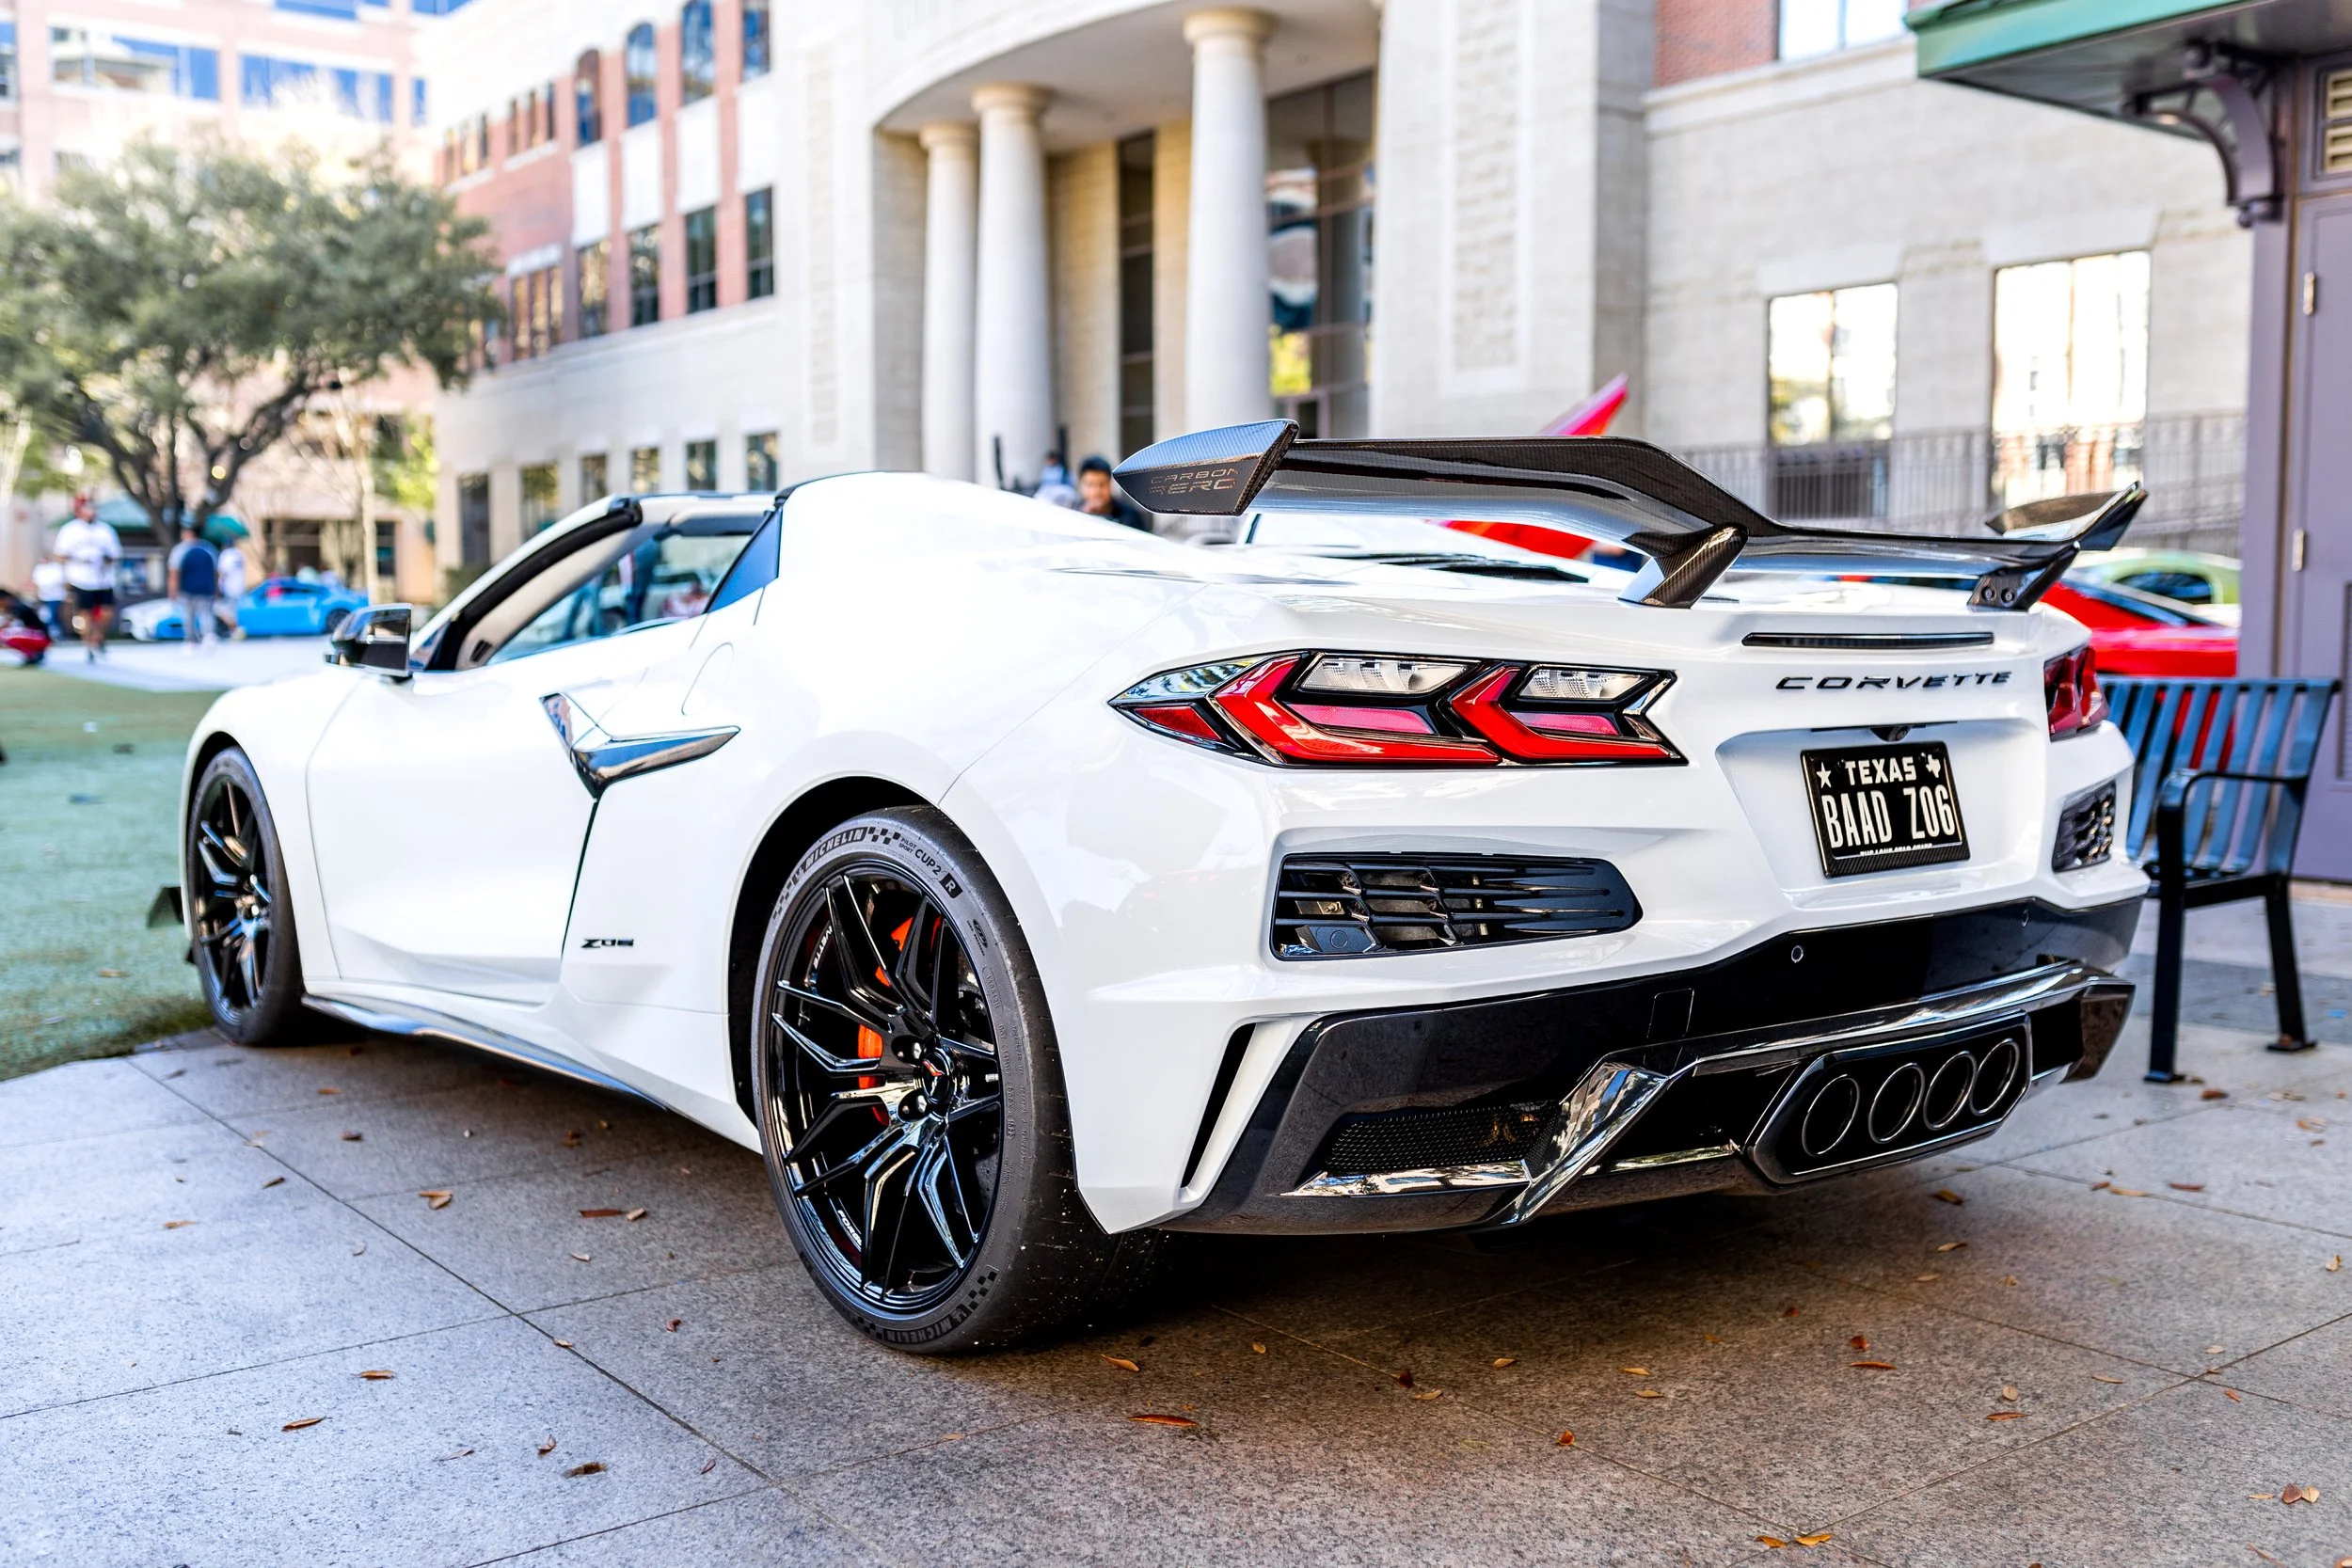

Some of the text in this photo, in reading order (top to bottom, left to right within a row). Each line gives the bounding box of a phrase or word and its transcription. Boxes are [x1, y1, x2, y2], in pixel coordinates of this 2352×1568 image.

[1151, 467, 1241, 484] CARBON
[1149, 478, 1236, 496] AERO
[1775, 671, 2012, 689] CORVETTE
[1844, 755, 1917, 785] TEXAS
[1820, 784, 1956, 848] BAAD Z06
[804, 828, 865, 870] MICHELIN
[898, 843, 914, 854] SPORT
[900, 837, 917, 849] PILOT
[885, 1317, 953, 1344] MICHELIN
